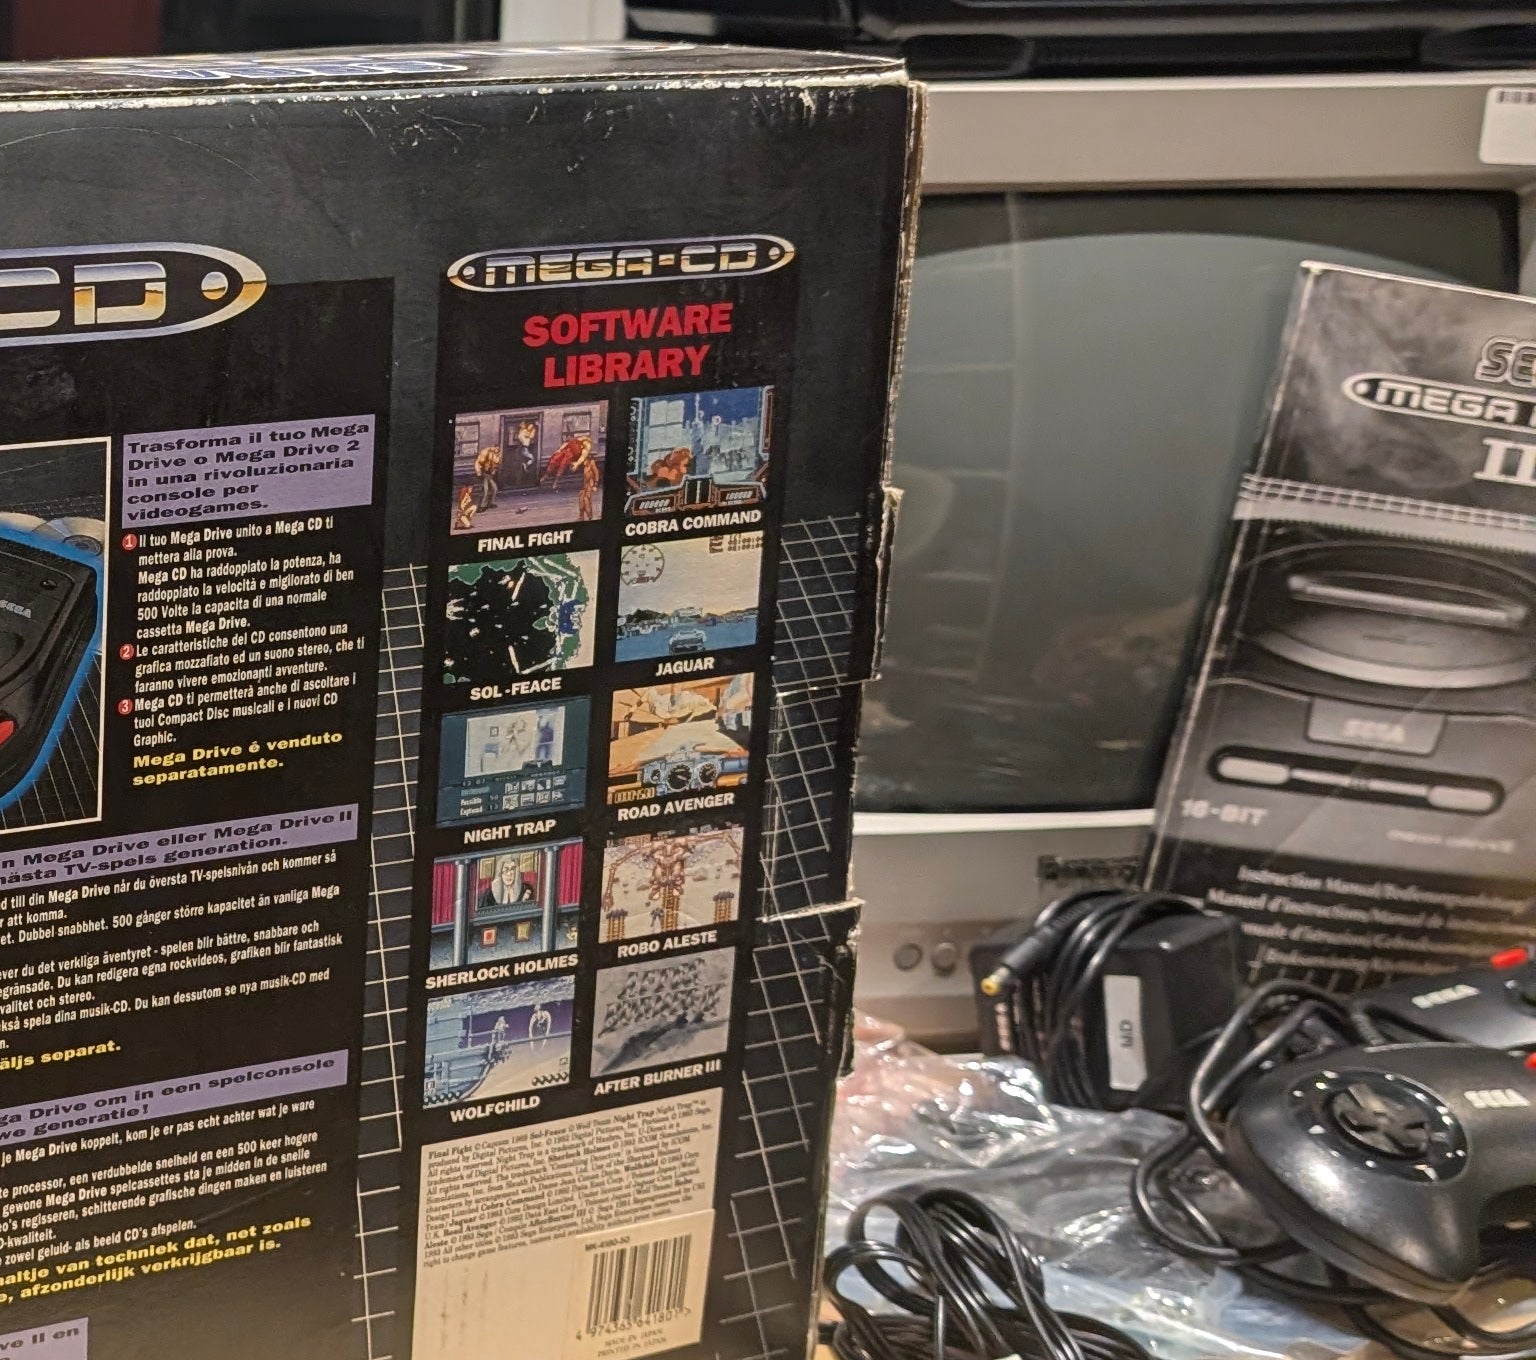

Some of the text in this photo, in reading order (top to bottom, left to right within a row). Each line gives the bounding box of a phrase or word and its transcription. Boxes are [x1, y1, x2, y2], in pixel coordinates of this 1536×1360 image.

[484, 241, 757, 286] MEGA-CD
[524, 303, 731, 347] SOFTWARE
[543, 345, 707, 387] LIBRARY
[1374, 380, 1520, 425] MEGA
[127, 422, 369, 454] Trasforma il tuo Mega
[128, 439, 360, 471] Drive o Mega Drive 2
[127, 456, 354, 488] in una rivoluzionaria
[126, 483, 259, 504] console per
[126, 499, 268, 521] videogames.
[624, 508, 762, 536] COBRA COMMAND
[477, 528, 573, 552] FINAL FIGHT
[654, 656, 715, 676] JAGUAR
[617, 791, 734, 821] ROAD AVENGER
[22, 848, 85, 865] Mega
[91, 839, 149, 856] Drive
[156, 831, 207, 847] eller
[213, 822, 272, 839] Mega
[279, 814, 334, 830] Drive
[338, 809, 352, 822] II
[463, 818, 556, 844] NIGHT TRAP
[63, 853, 157, 875] TV-spels
[162, 836, 287, 864] generation.
[616, 929, 717, 958] ROBO ALESTE
[425, 953, 578, 989] SHERLOCK HOLMES
[29, 1101, 87, 1120] Drive
[93, 1094, 127, 1108] om
[134, 1089, 153, 1101] in
[160, 1081, 201, 1096] een
[207, 1058, 335, 1088] spelconsole
[593, 1058, 721, 1096] AFTER BURNER III
[33, 1103, 148, 1136] generatie!
[449, 1095, 540, 1122] WOLFCHILD
